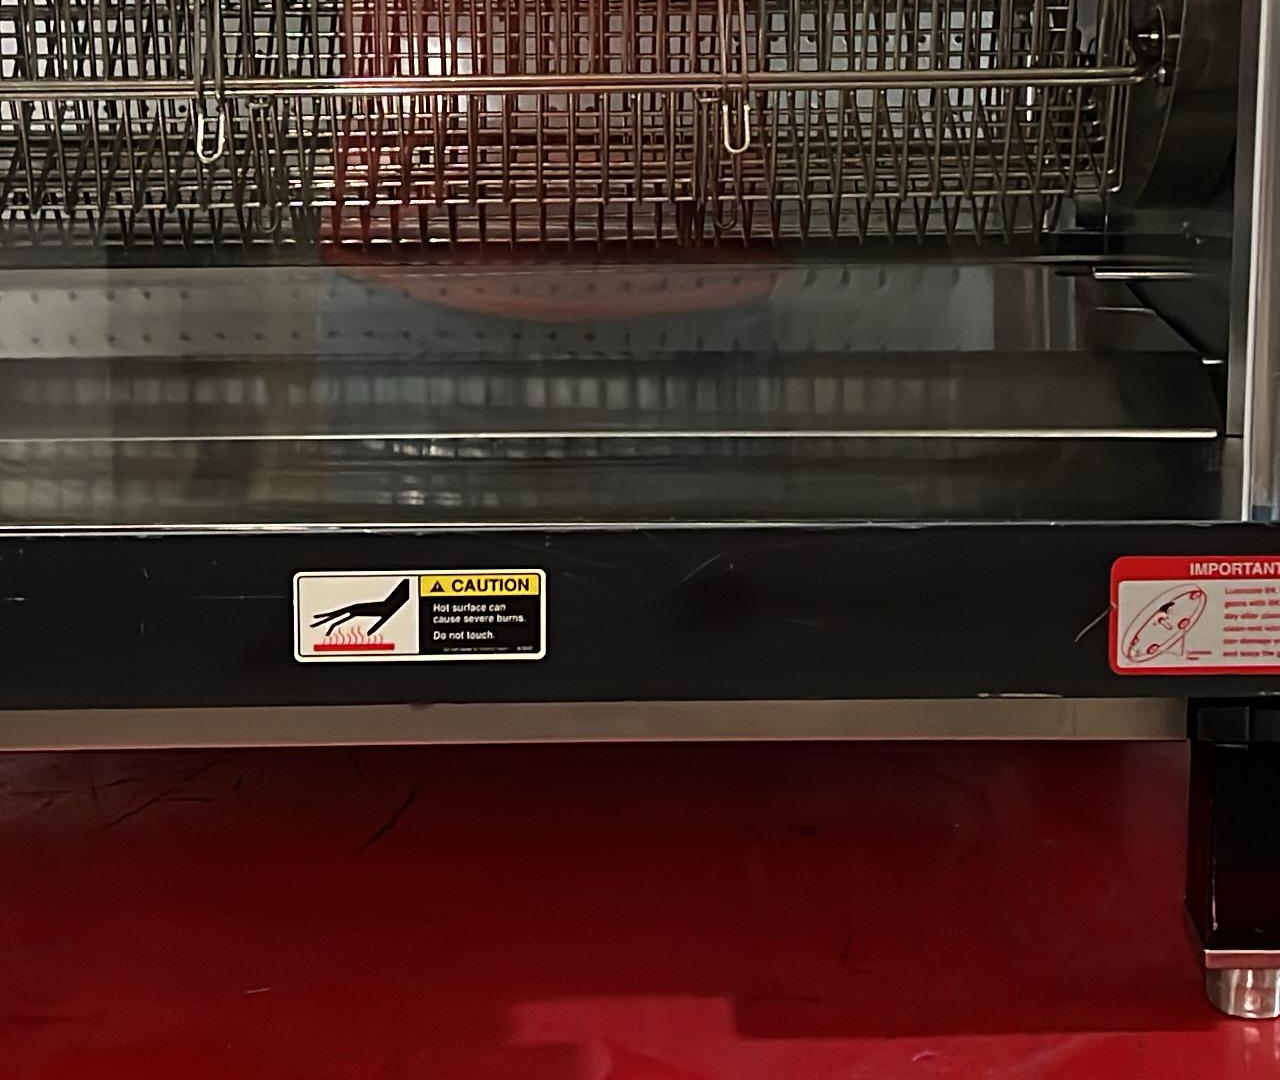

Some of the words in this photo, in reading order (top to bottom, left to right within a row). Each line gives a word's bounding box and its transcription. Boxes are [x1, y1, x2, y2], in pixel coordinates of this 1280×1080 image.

[451, 578, 530, 593] CAUTION
[433, 603, 450, 612] Hot
[452, 603, 487, 612] surface
[489, 603, 507, 612] can
[433, 615, 461, 624] cause
[463, 615, 494, 623] severe
[433, 630, 446, 640] Do
[449, 631, 465, 640] not
